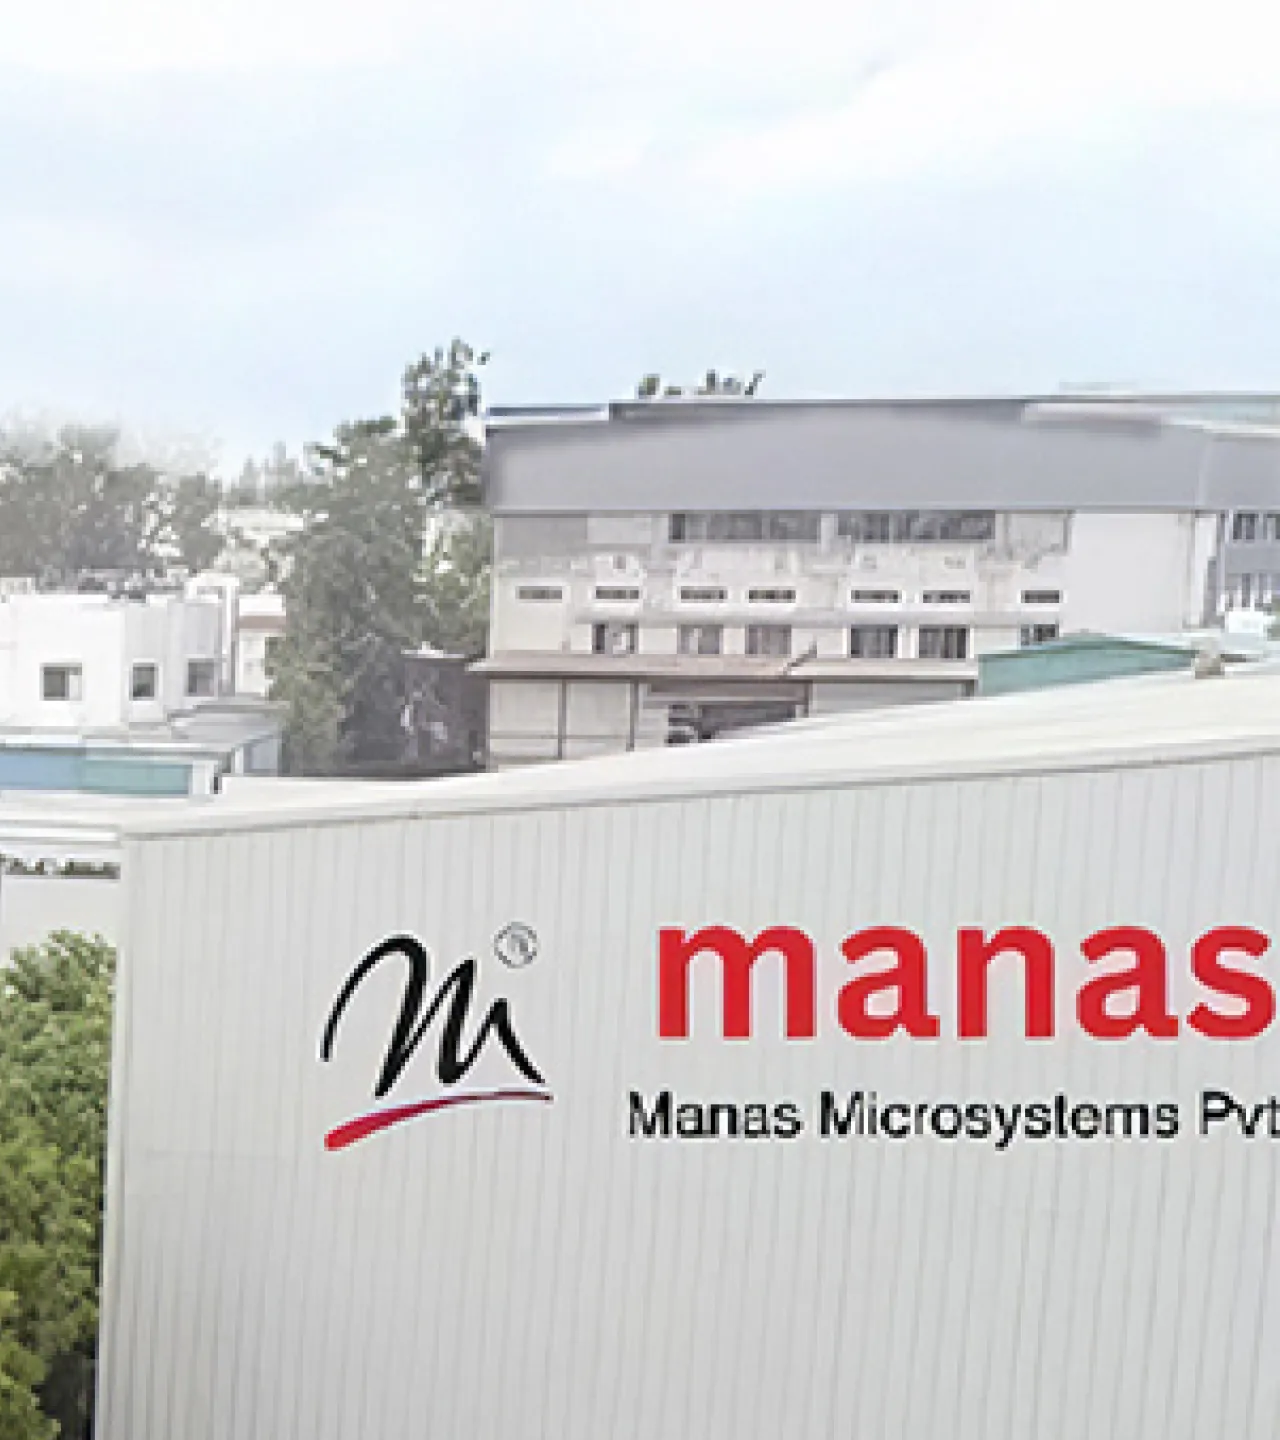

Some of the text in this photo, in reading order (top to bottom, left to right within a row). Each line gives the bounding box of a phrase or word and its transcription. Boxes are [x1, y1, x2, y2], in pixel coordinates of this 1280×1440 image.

[657, 925, 1278, 1040] manas
[628, 1090, 803, 1139] Manas
[819, 1090, 1181, 1152] Microsystems
